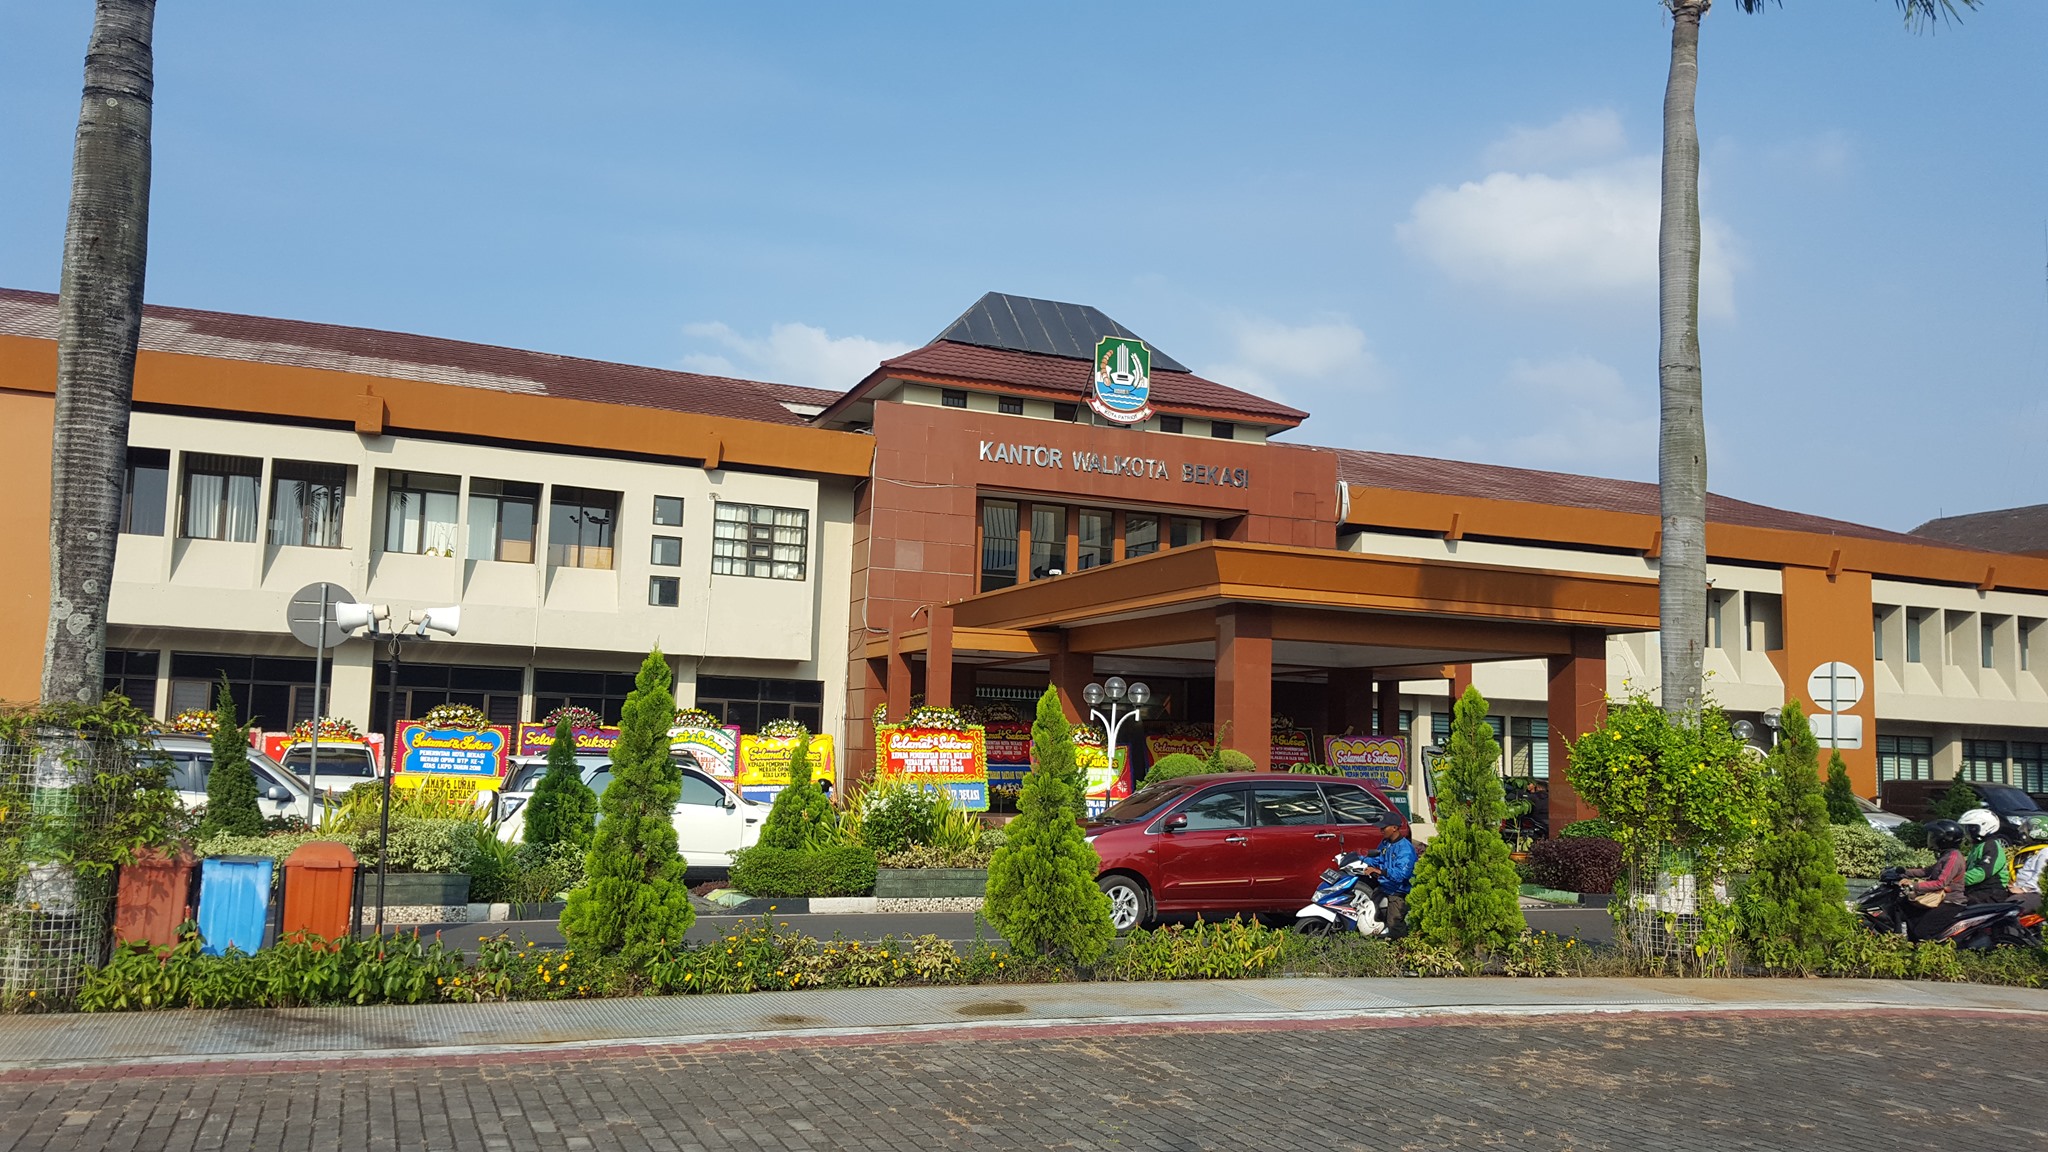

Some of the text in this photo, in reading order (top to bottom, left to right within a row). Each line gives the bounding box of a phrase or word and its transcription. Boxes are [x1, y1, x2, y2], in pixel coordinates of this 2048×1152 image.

[1104, 410, 1117, 418] KOTA
[979, 440, 1249, 490] KANTOR WALIKOTA BEKASI
[412, 732, 453, 748] Selamat
[460, 735, 493, 750] Sukses
[525, 731, 617, 749] Sela Sukses
[890, 734, 933, 749] Selamat
[939, 735, 973, 749] Sukses
[1279, 734, 1306, 747] Sukses
[1089, 753, 1119, 767] Sukss
[1336, 750, 1367, 764] Selamat
[1372, 750, 1398, 764] Sukses
